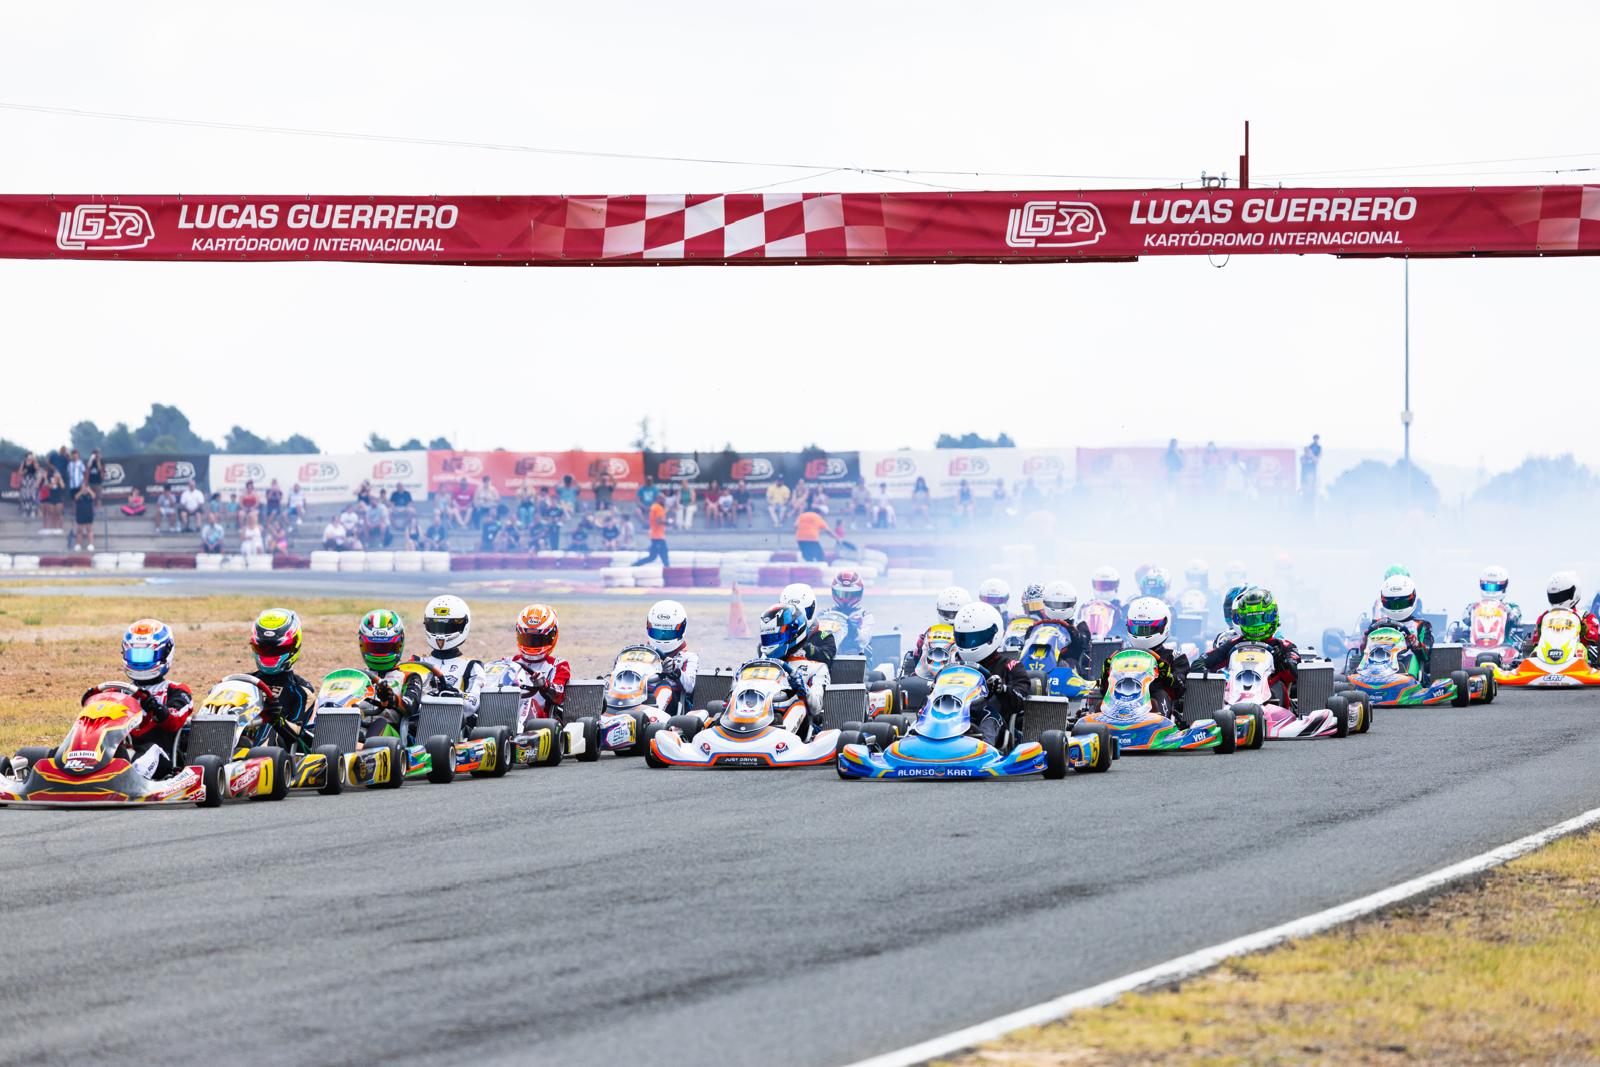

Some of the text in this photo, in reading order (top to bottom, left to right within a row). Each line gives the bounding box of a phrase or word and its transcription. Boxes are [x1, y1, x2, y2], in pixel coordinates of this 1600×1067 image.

[178, 204, 459, 229] LUCAS GUERRERO
[1129, 196, 1417, 225] LUCAS GUERRERO
[191, 235, 445, 251] KARTÓDROMO INTERNACIONAL
[1143, 231, 1403, 247] KARTÓDROMO INTERNACIONAL
